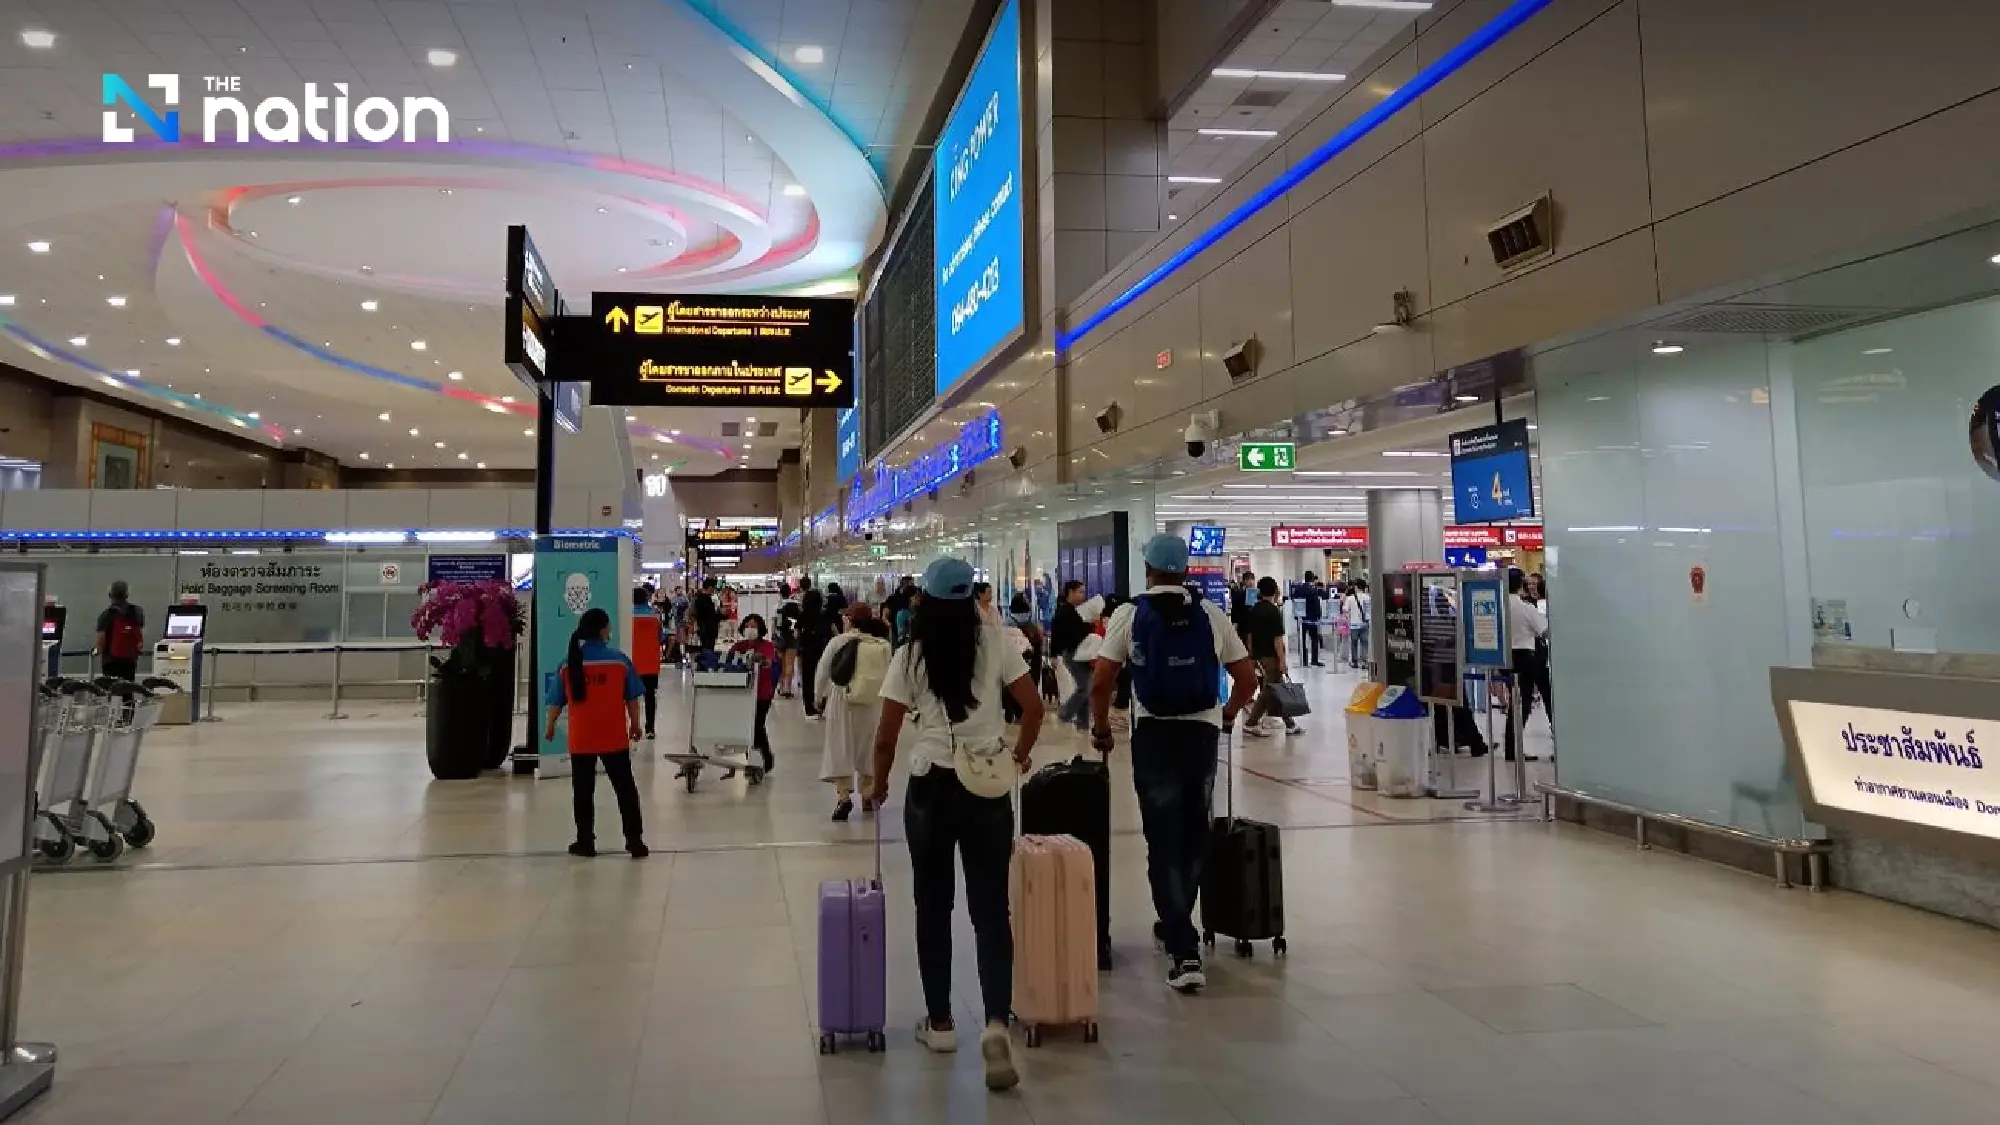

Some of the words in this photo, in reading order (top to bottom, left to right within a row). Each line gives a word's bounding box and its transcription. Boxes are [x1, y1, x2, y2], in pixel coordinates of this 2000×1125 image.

[970, 90, 999, 169] POWER
[553, 540, 600, 549] Biometric
[200, 562, 323, 578] ห้องตรวจสัมภาระ
[181, 582, 204, 594] Hold
[207, 582, 252, 597] Baggage
[255, 582, 306, 596] Screening
[309, 582, 339, 594] Room
[1842, 722, 1984, 769] ประชาสัมพันธ์
[1854, 775, 1970, 811] ท่าอากาศยานดอนเมือง
